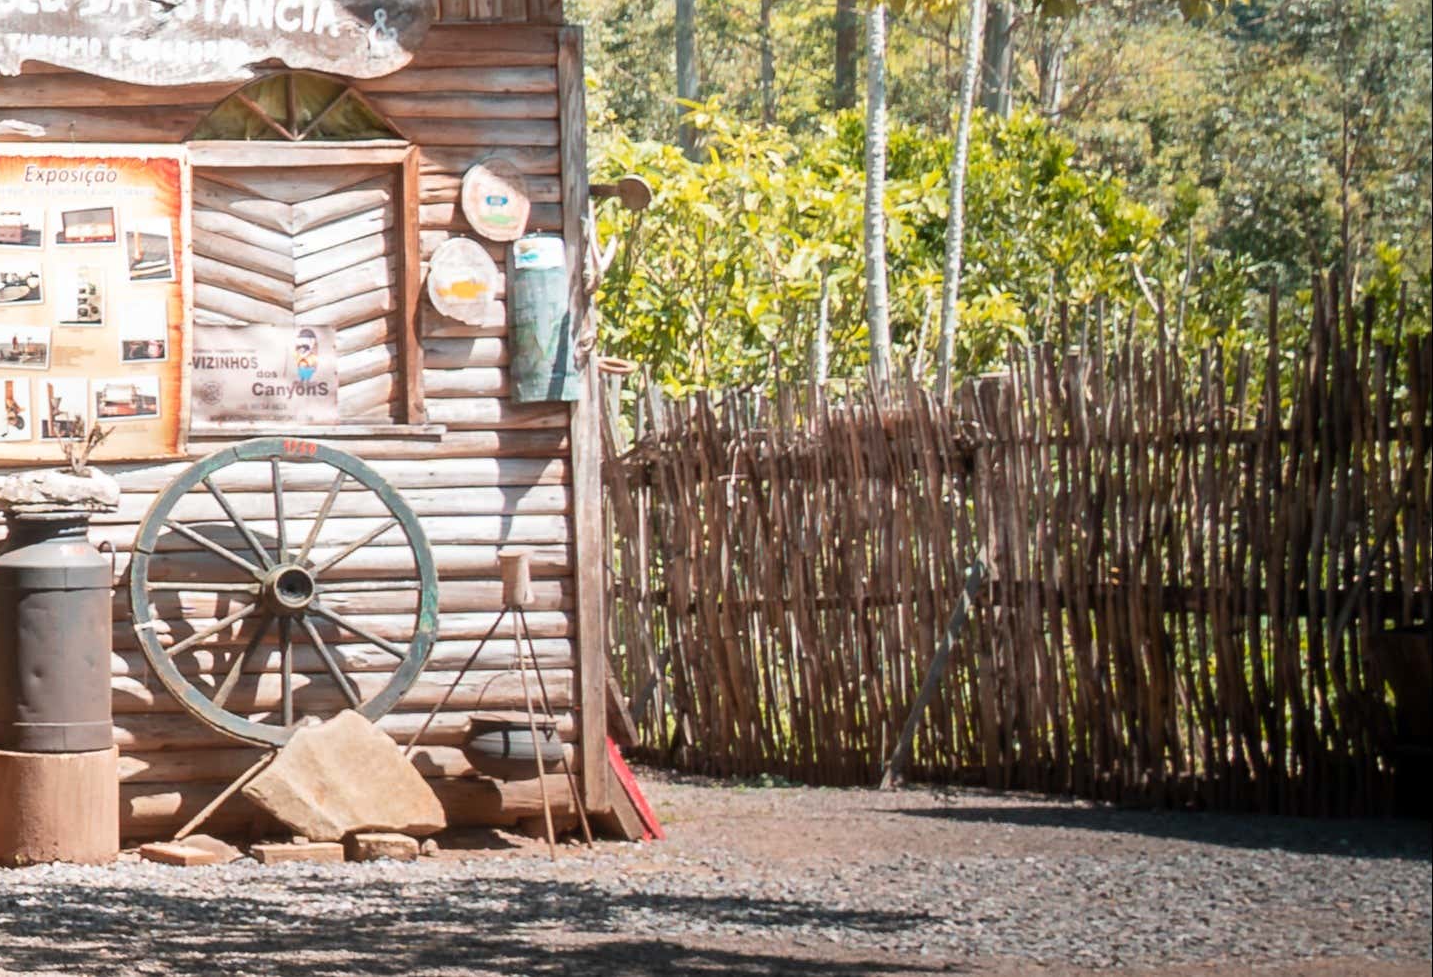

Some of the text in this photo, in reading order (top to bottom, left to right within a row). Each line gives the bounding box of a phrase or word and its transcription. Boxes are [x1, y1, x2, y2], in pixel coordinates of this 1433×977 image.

[24, 165, 118, 186] Exposição
[192, 356, 259, 370] VIZINHOS
[256, 369, 278, 379] dos
